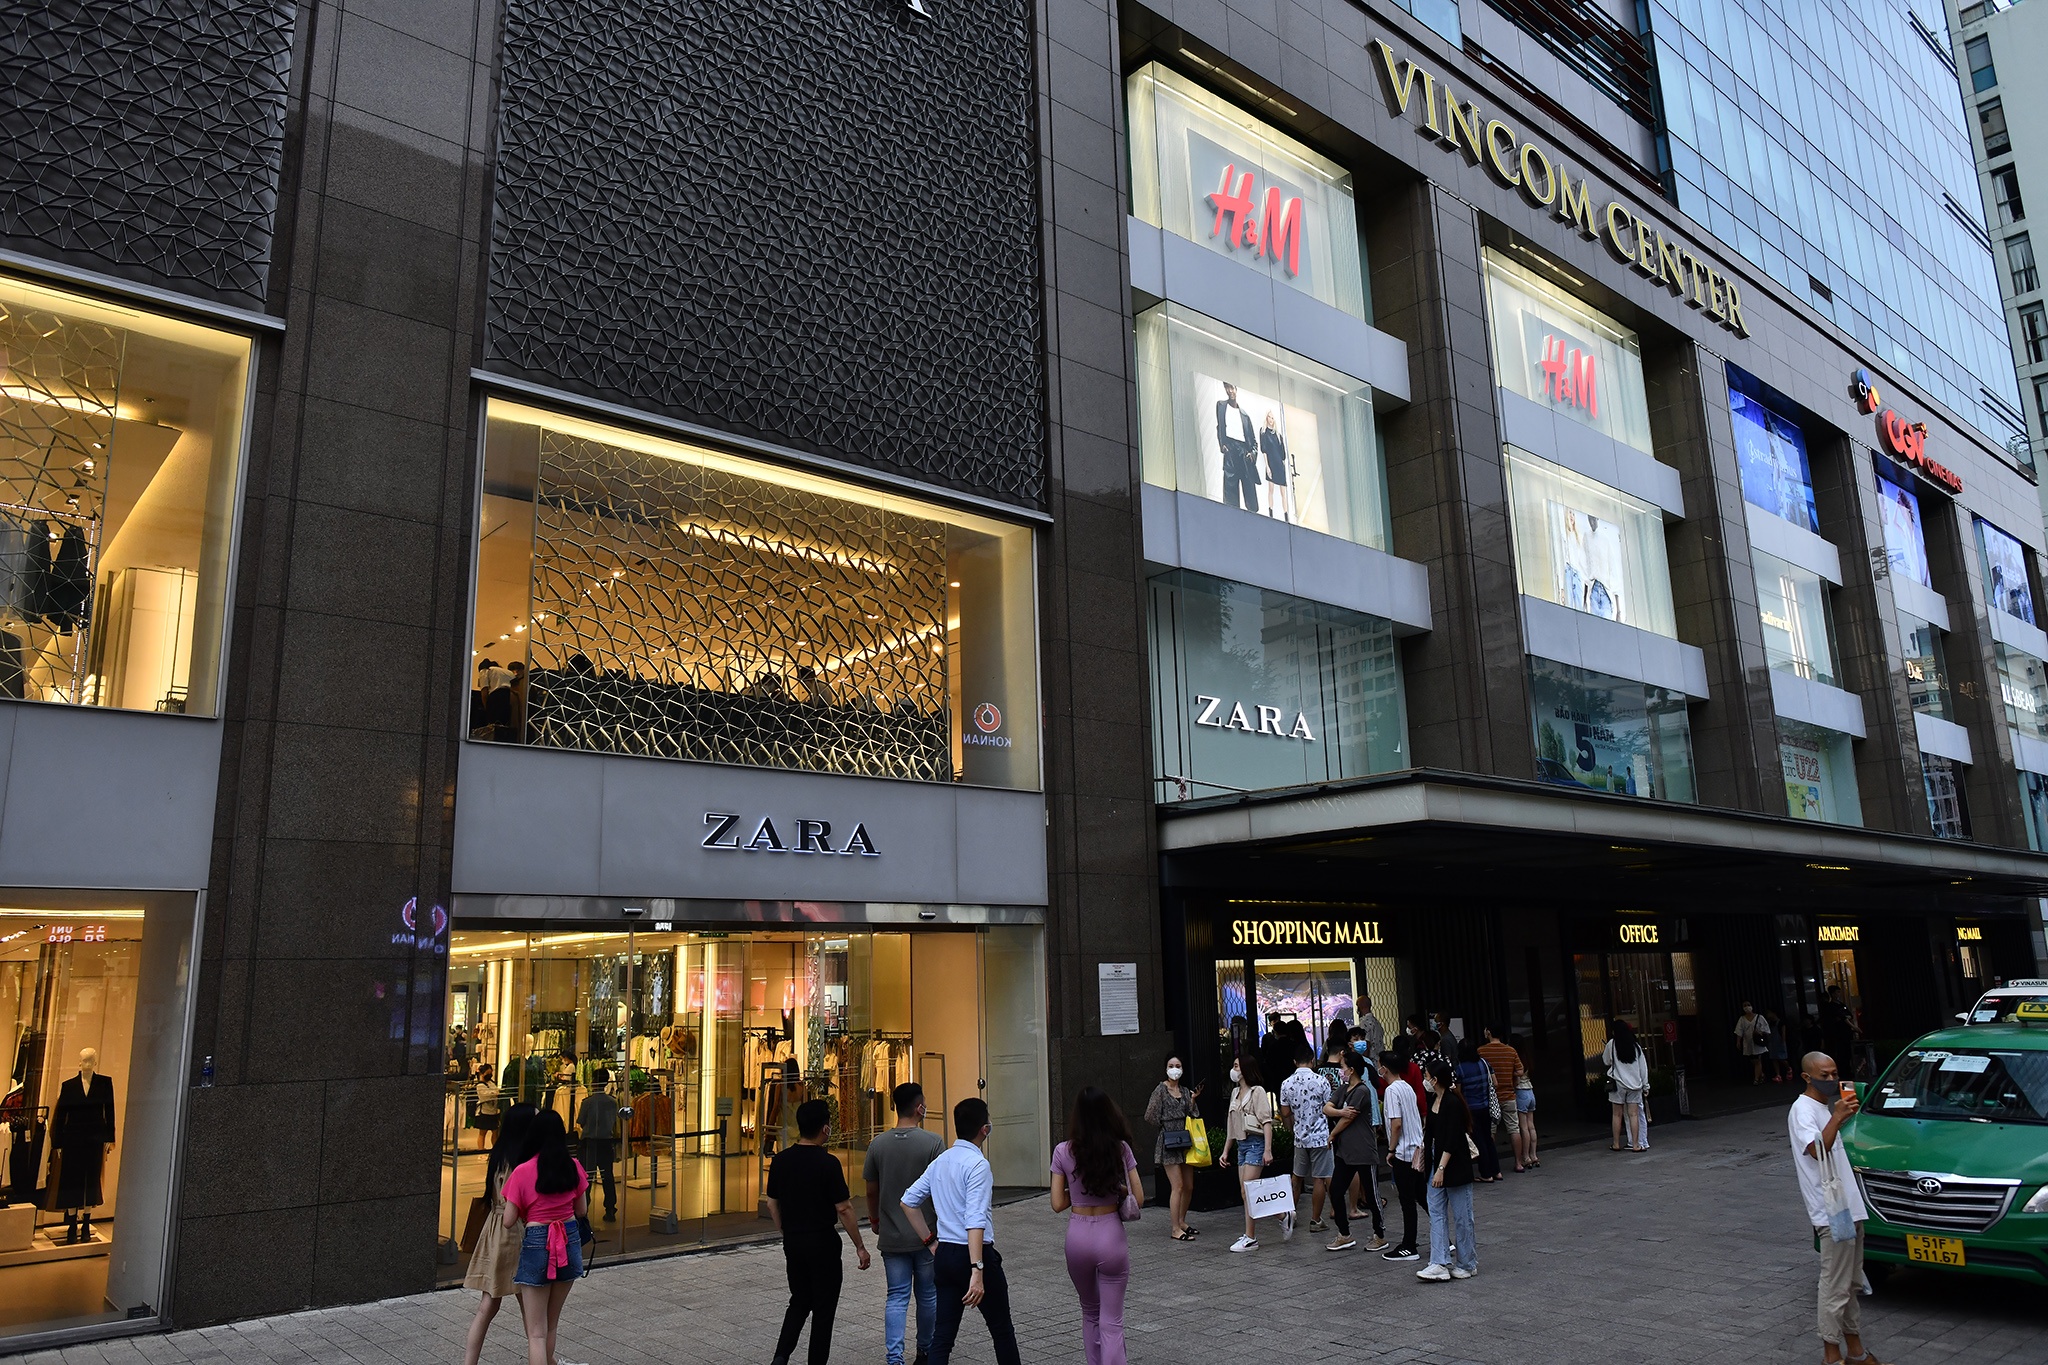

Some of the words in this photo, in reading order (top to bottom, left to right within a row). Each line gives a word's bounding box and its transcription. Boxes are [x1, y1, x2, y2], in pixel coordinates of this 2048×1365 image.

[1374, 37, 1600, 239] VINCOM
[1606, 201, 1752, 339] CENTER
[1206, 163, 1302, 278] H&M
[1537, 333, 1598, 420] H&M
[1882, 409, 1927, 467] CGV
[1926, 456, 1964, 493] CINEMAS
[1195, 694, 1317, 742] ZARA
[1574, 722, 1596, 772] 5
[702, 811, 882, 857] ZARA
[1232, 919, 1332, 945] SHOPPING
[1334, 921, 1383, 944] MALL
[1619, 924, 1659, 943] OFFICE
[1818, 926, 1860, 941] APARTMENT
[1255, 1190, 1287, 1205] ALDO
[1913, 1247, 1959, 1264] 511.67
[1922, 1236, 1947, 1249] 51F
